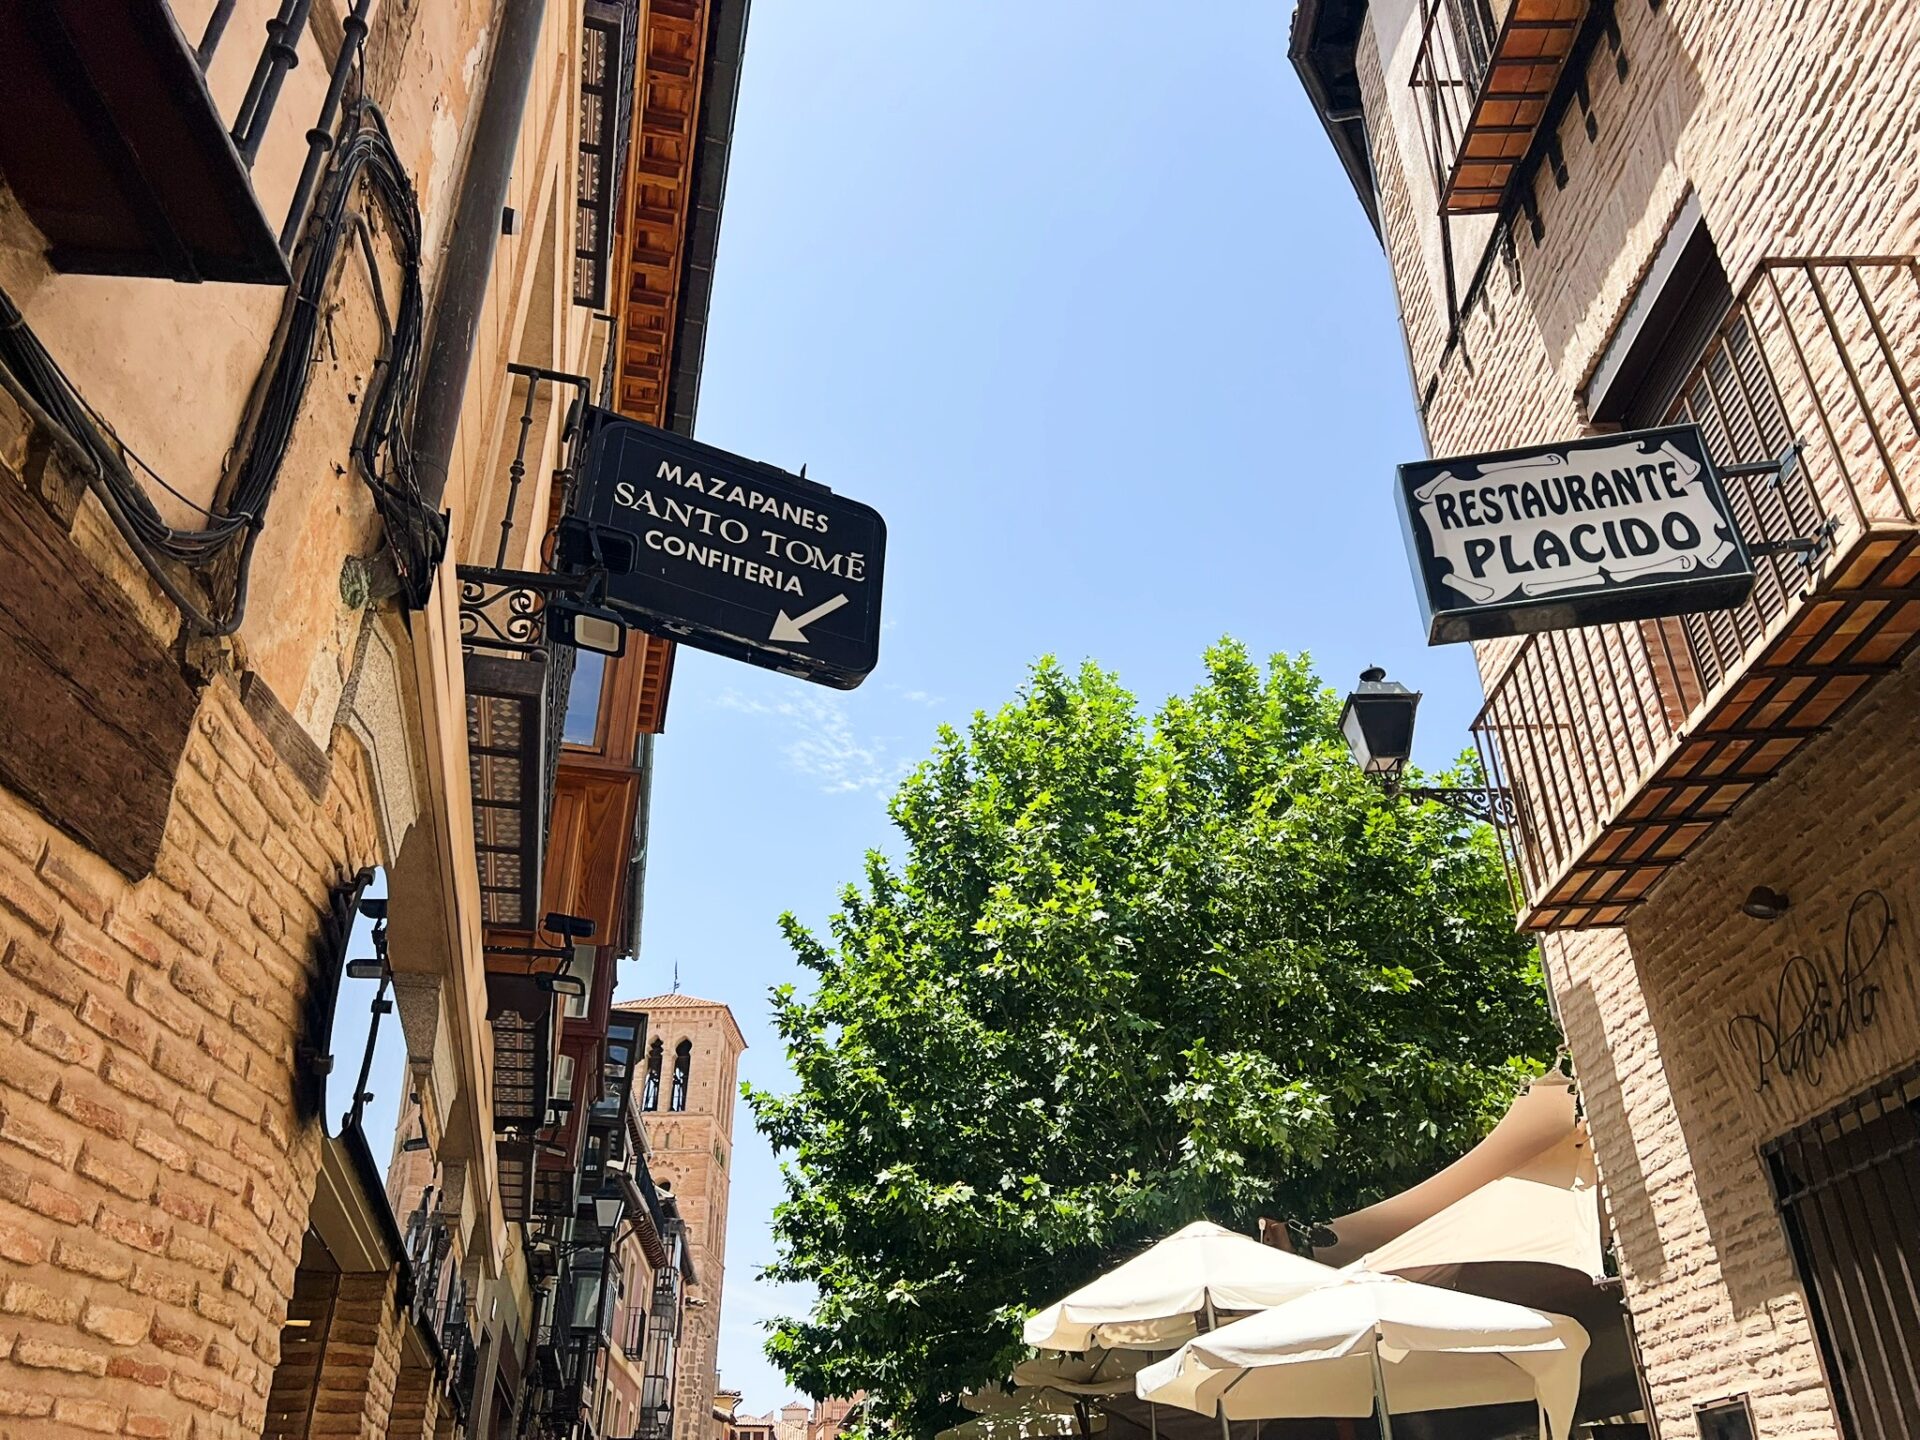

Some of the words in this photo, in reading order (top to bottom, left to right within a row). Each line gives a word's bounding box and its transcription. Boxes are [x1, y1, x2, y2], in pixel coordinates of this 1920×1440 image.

[656, 461, 829, 532] MAZAPANES
[1435, 461, 1688, 529] RESTAURANTE
[614, 482, 748, 543] SANTO
[761, 531, 866, 582] TOMÉ
[645, 531, 804, 596] CONFITERIA
[1464, 512, 1701, 578] PLACIDO
